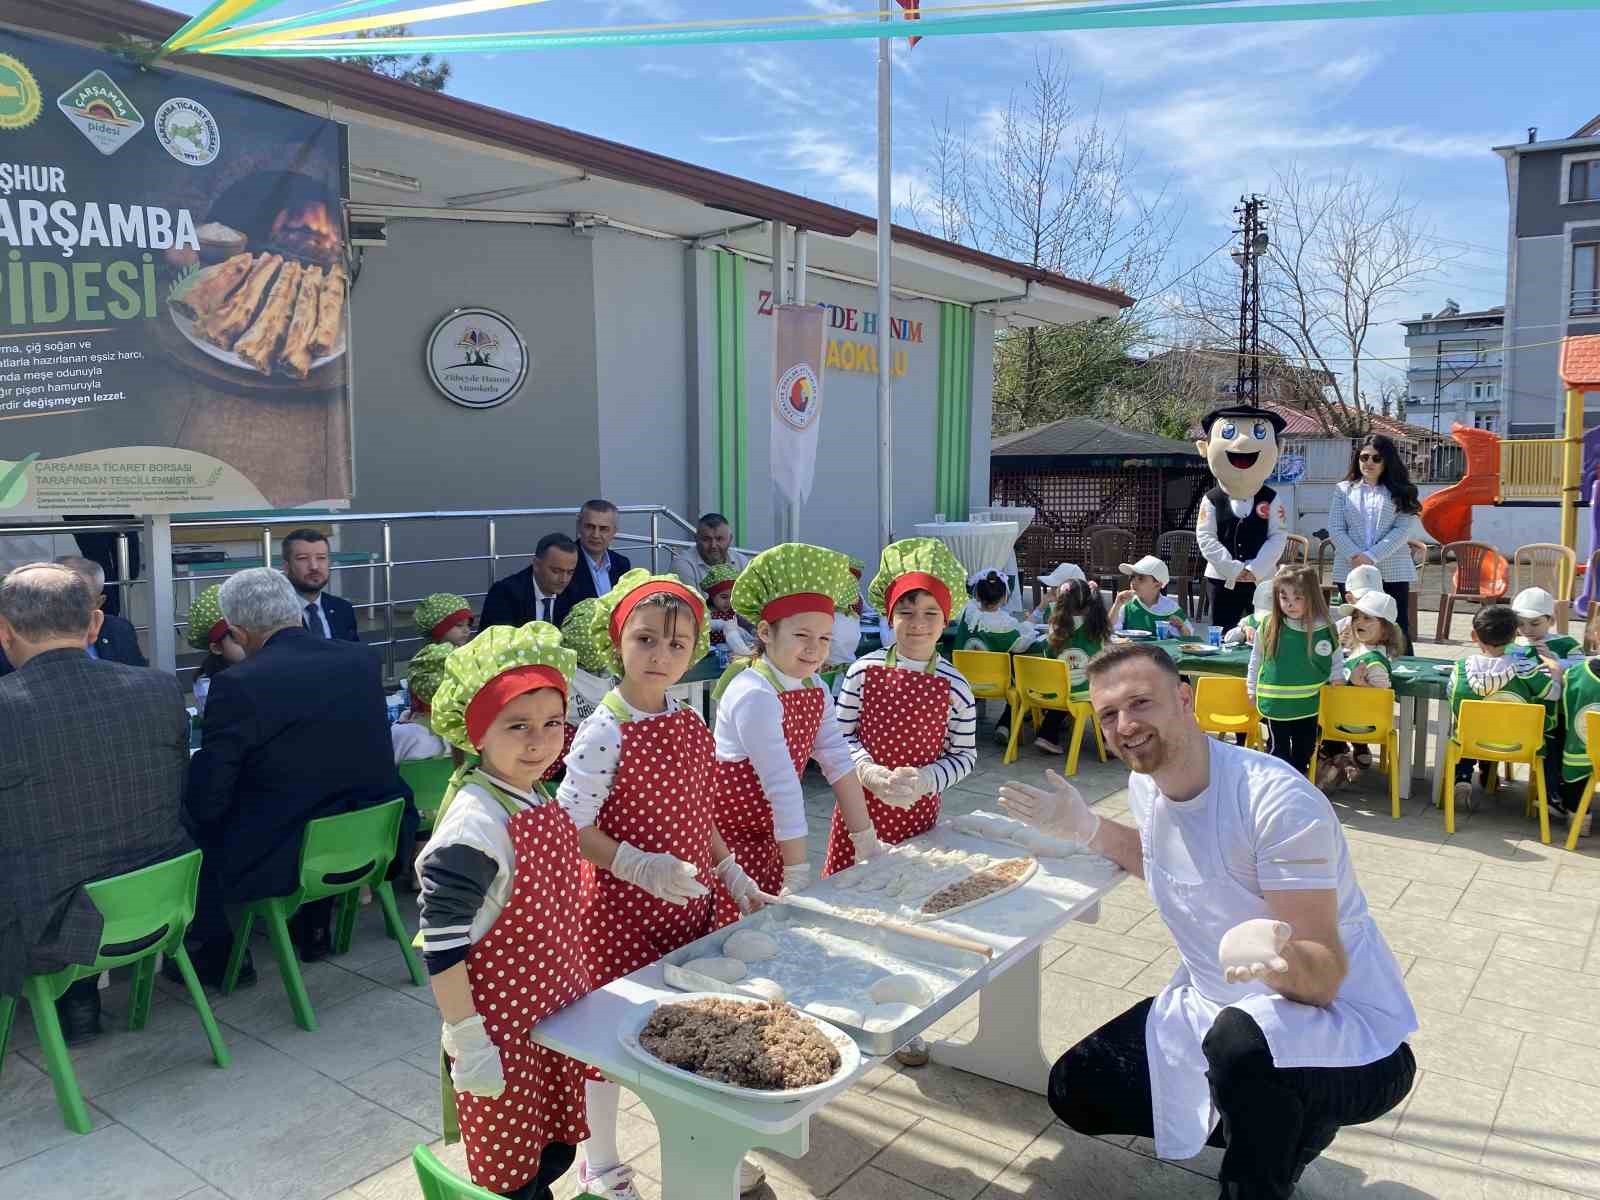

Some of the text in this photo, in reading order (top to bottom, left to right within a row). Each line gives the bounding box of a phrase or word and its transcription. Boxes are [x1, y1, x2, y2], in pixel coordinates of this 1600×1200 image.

[75, 86, 126, 116] ÇARŞAMBA
[0, 250, 157, 325] İDESİ
[26, 342, 41, 353] çiğ
[45, 341, 76, 351] soğan
[80, 341, 91, 349] ve
[33, 354, 88, 366] hazırlanan
[90, 351, 115, 362] eşsiz
[24, 371, 53, 381] meşe
[57, 366, 103, 378] odunuyla
[15, 385, 45, 397] pişen
[48, 379, 102, 392] hamuruyla
[23, 394, 91, 409] değişmeyen
